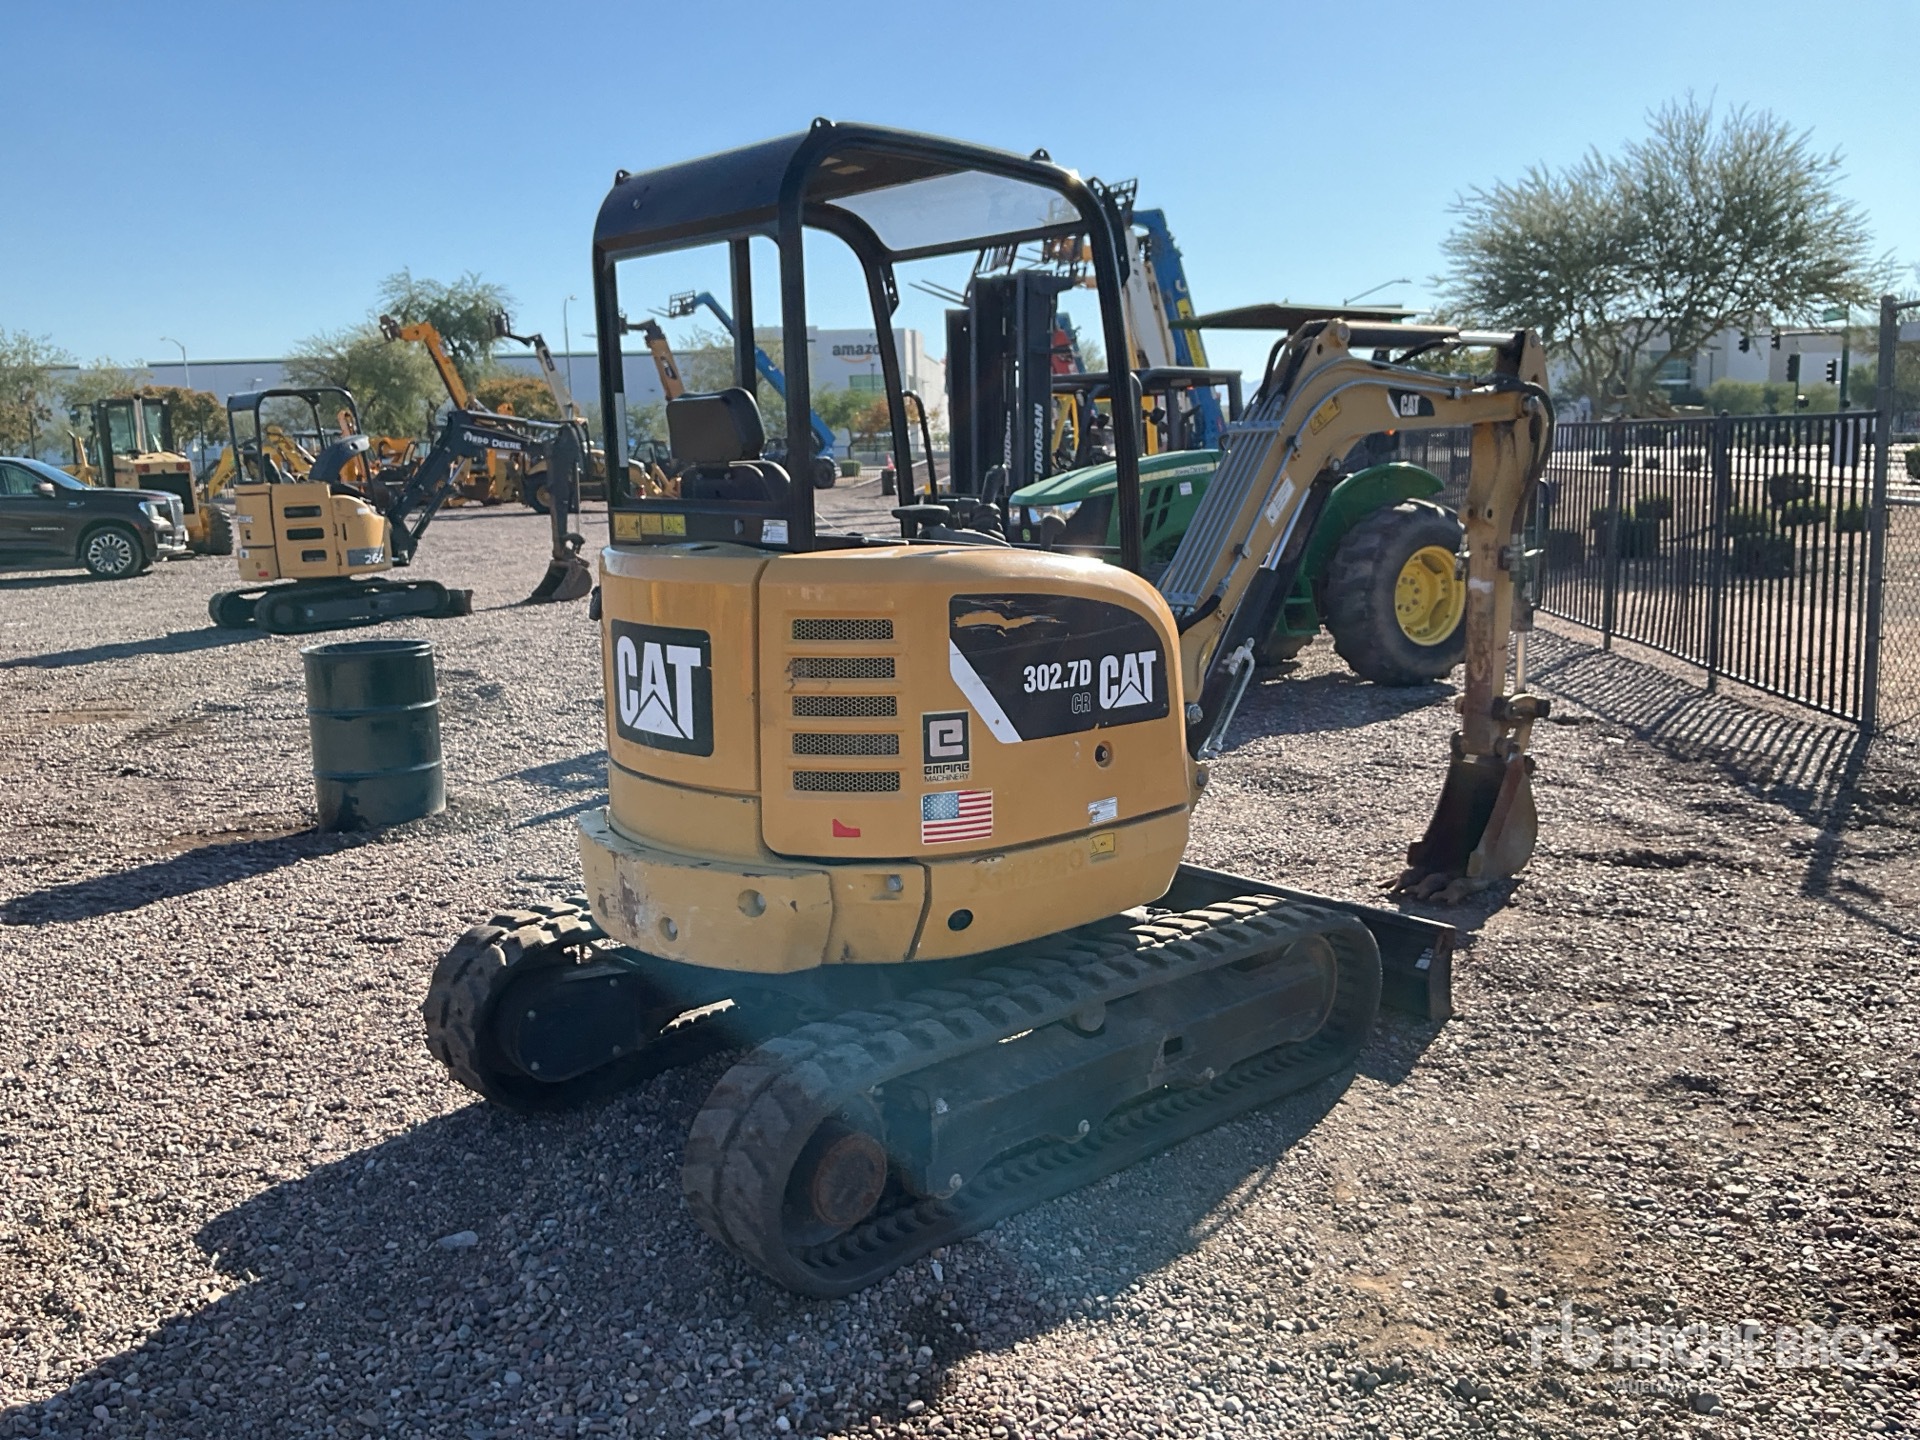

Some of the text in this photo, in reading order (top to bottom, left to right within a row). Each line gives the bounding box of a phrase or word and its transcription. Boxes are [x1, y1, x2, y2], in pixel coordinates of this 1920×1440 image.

[833, 344, 881, 356] amazo
[1400, 394, 1420, 416] CAT
[1034, 402, 1043, 474] DOOSAN
[617, 635, 701, 740] CAT
[1023, 650, 1157, 709] 302.7D CAT
[1071, 692, 1091, 714] CR
[924, 773, 970, 782] MACHINERY
